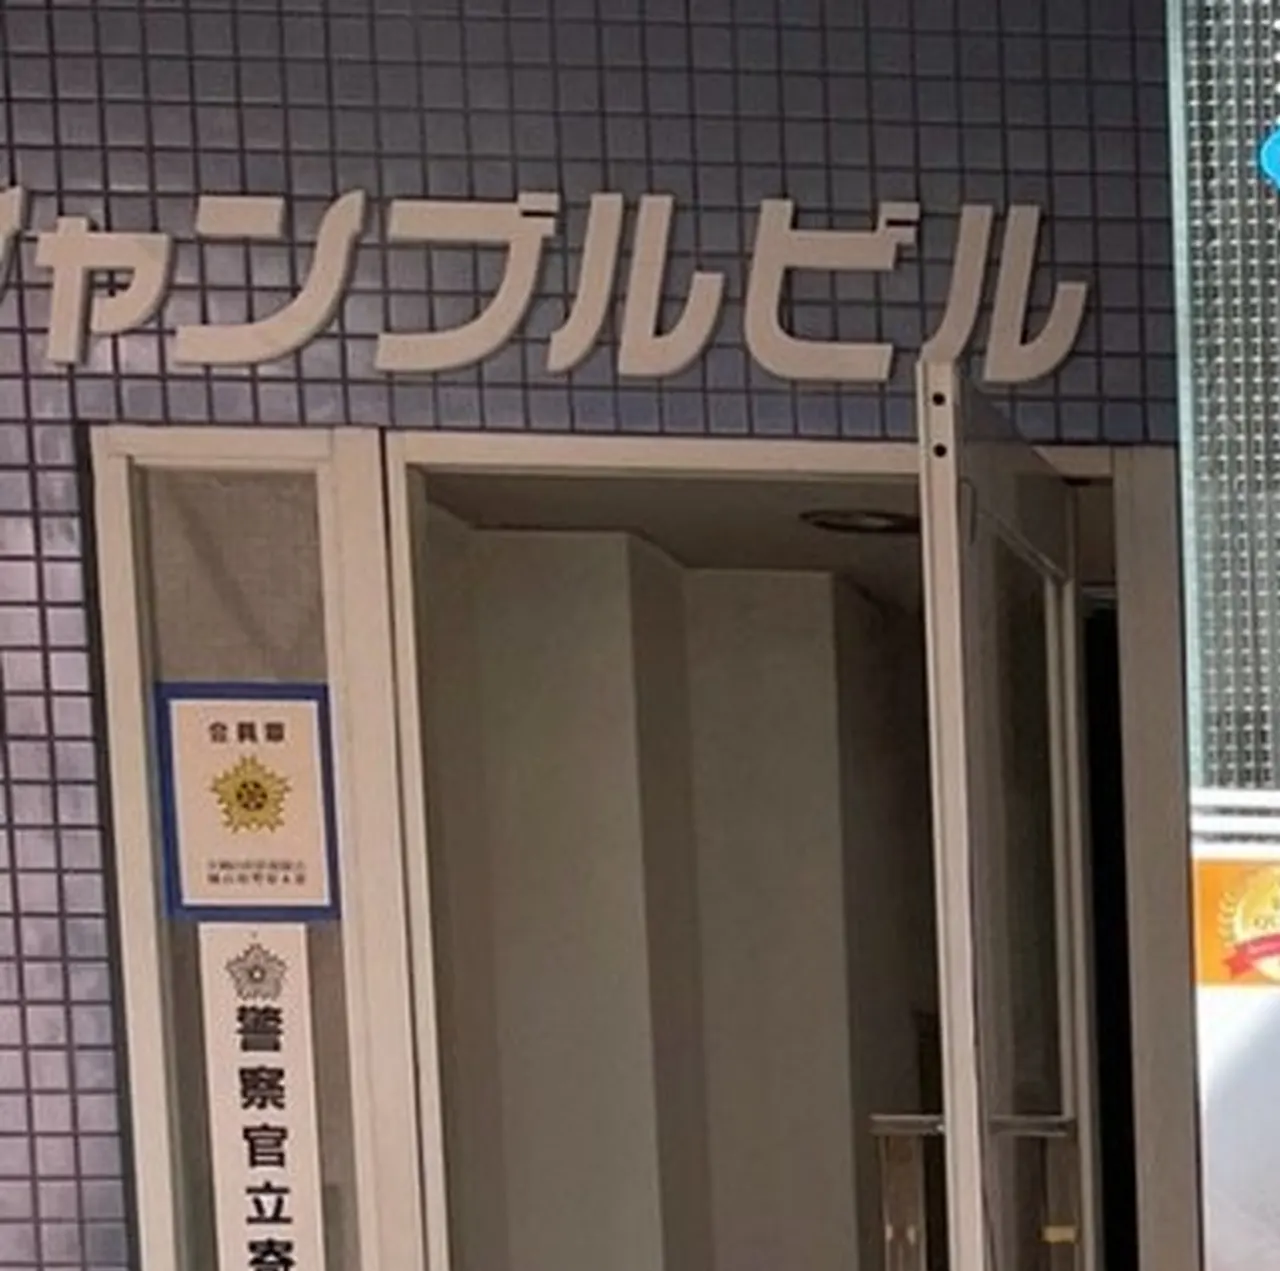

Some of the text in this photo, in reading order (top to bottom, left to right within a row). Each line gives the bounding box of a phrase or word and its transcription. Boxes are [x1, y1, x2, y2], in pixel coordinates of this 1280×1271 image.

[0, 187, 1088, 384] ャンブルビル
